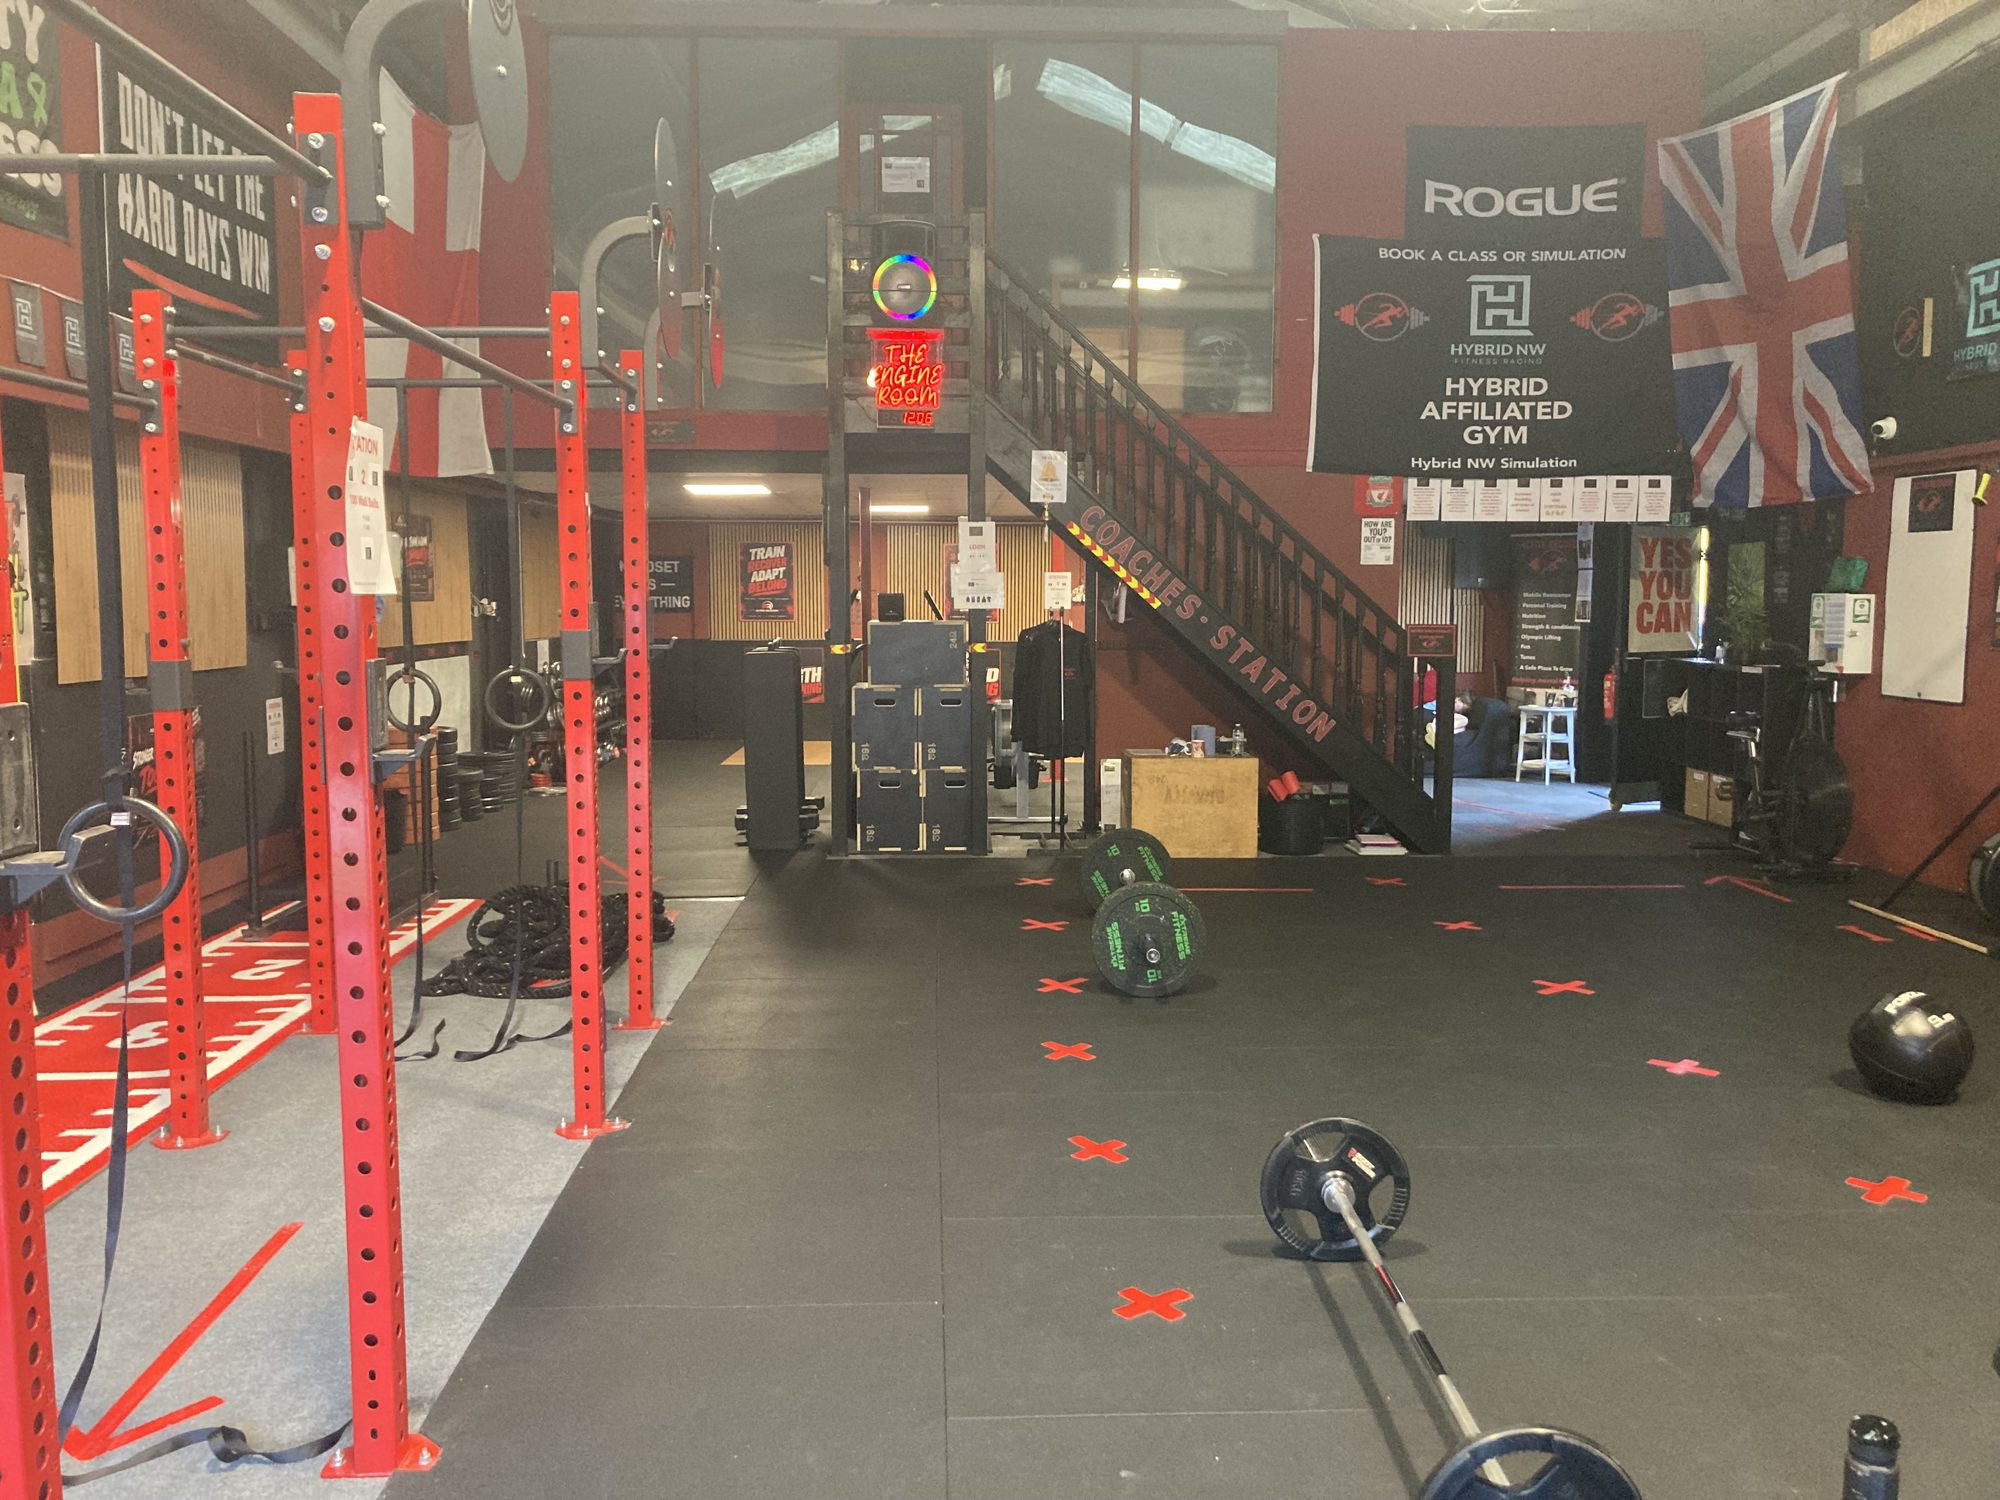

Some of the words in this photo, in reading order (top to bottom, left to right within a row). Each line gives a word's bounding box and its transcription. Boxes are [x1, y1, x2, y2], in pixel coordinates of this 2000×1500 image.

[118, 71, 184, 181] DON'T
[192, 123, 225, 202] LET
[1424, 177, 1618, 217] ROGUE
[118, 172, 177, 257] HARD
[183, 199, 231, 281] DAYS
[236, 225, 270, 294] WIN
[1378, 247, 1425, 261] BOOK
[1431, 250, 1442, 261] A
[1448, 250, 1497, 262] CLASS
[1503, 250, 1526, 262] OR
[1531, 248, 1627, 262] SIMULATION
[885, 344, 927, 366] THE
[1450, 343, 1513, 356] HYBRID
[1516, 343, 1547, 356] NW
[1953, 342, 1997, 362] HYBRID
[874, 364, 942, 387] ENGINE
[879, 386, 937, 406] ROOM
[1445, 377, 1548, 396] HYBRID
[1420, 401, 1573, 420] AFFILIATED
[1463, 425, 1528, 445] GYM
[1411, 457, 1461, 471] Hybrid
[1467, 458, 1495, 469] NW
[1500, 457, 1577, 469] Simulation
[1369, 528, 1387, 537] YOU?
[750, 545, 785, 560] TRAIN
[1639, 537, 1692, 569] YES
[748, 557, 787, 573] RECOVER
[751, 567, 786, 582] ADAPT
[748, 578, 787, 594] BELONG
[1639, 570, 1692, 600] YOU
[1079, 505, 1202, 619] COACHES
[1209, 624, 1336, 742] STATION
[1636, 601, 1692, 634] CAN
[1139, 899, 1151, 913] 10
[1171, 911, 1186, 960] FITNESS
[1179, 914, 1191, 955] EXTREME
[1106, 927, 1118, 967] EXTREME
[1111, 921, 1126, 970] FITNESS
[1146, 969, 1157, 983] 10
